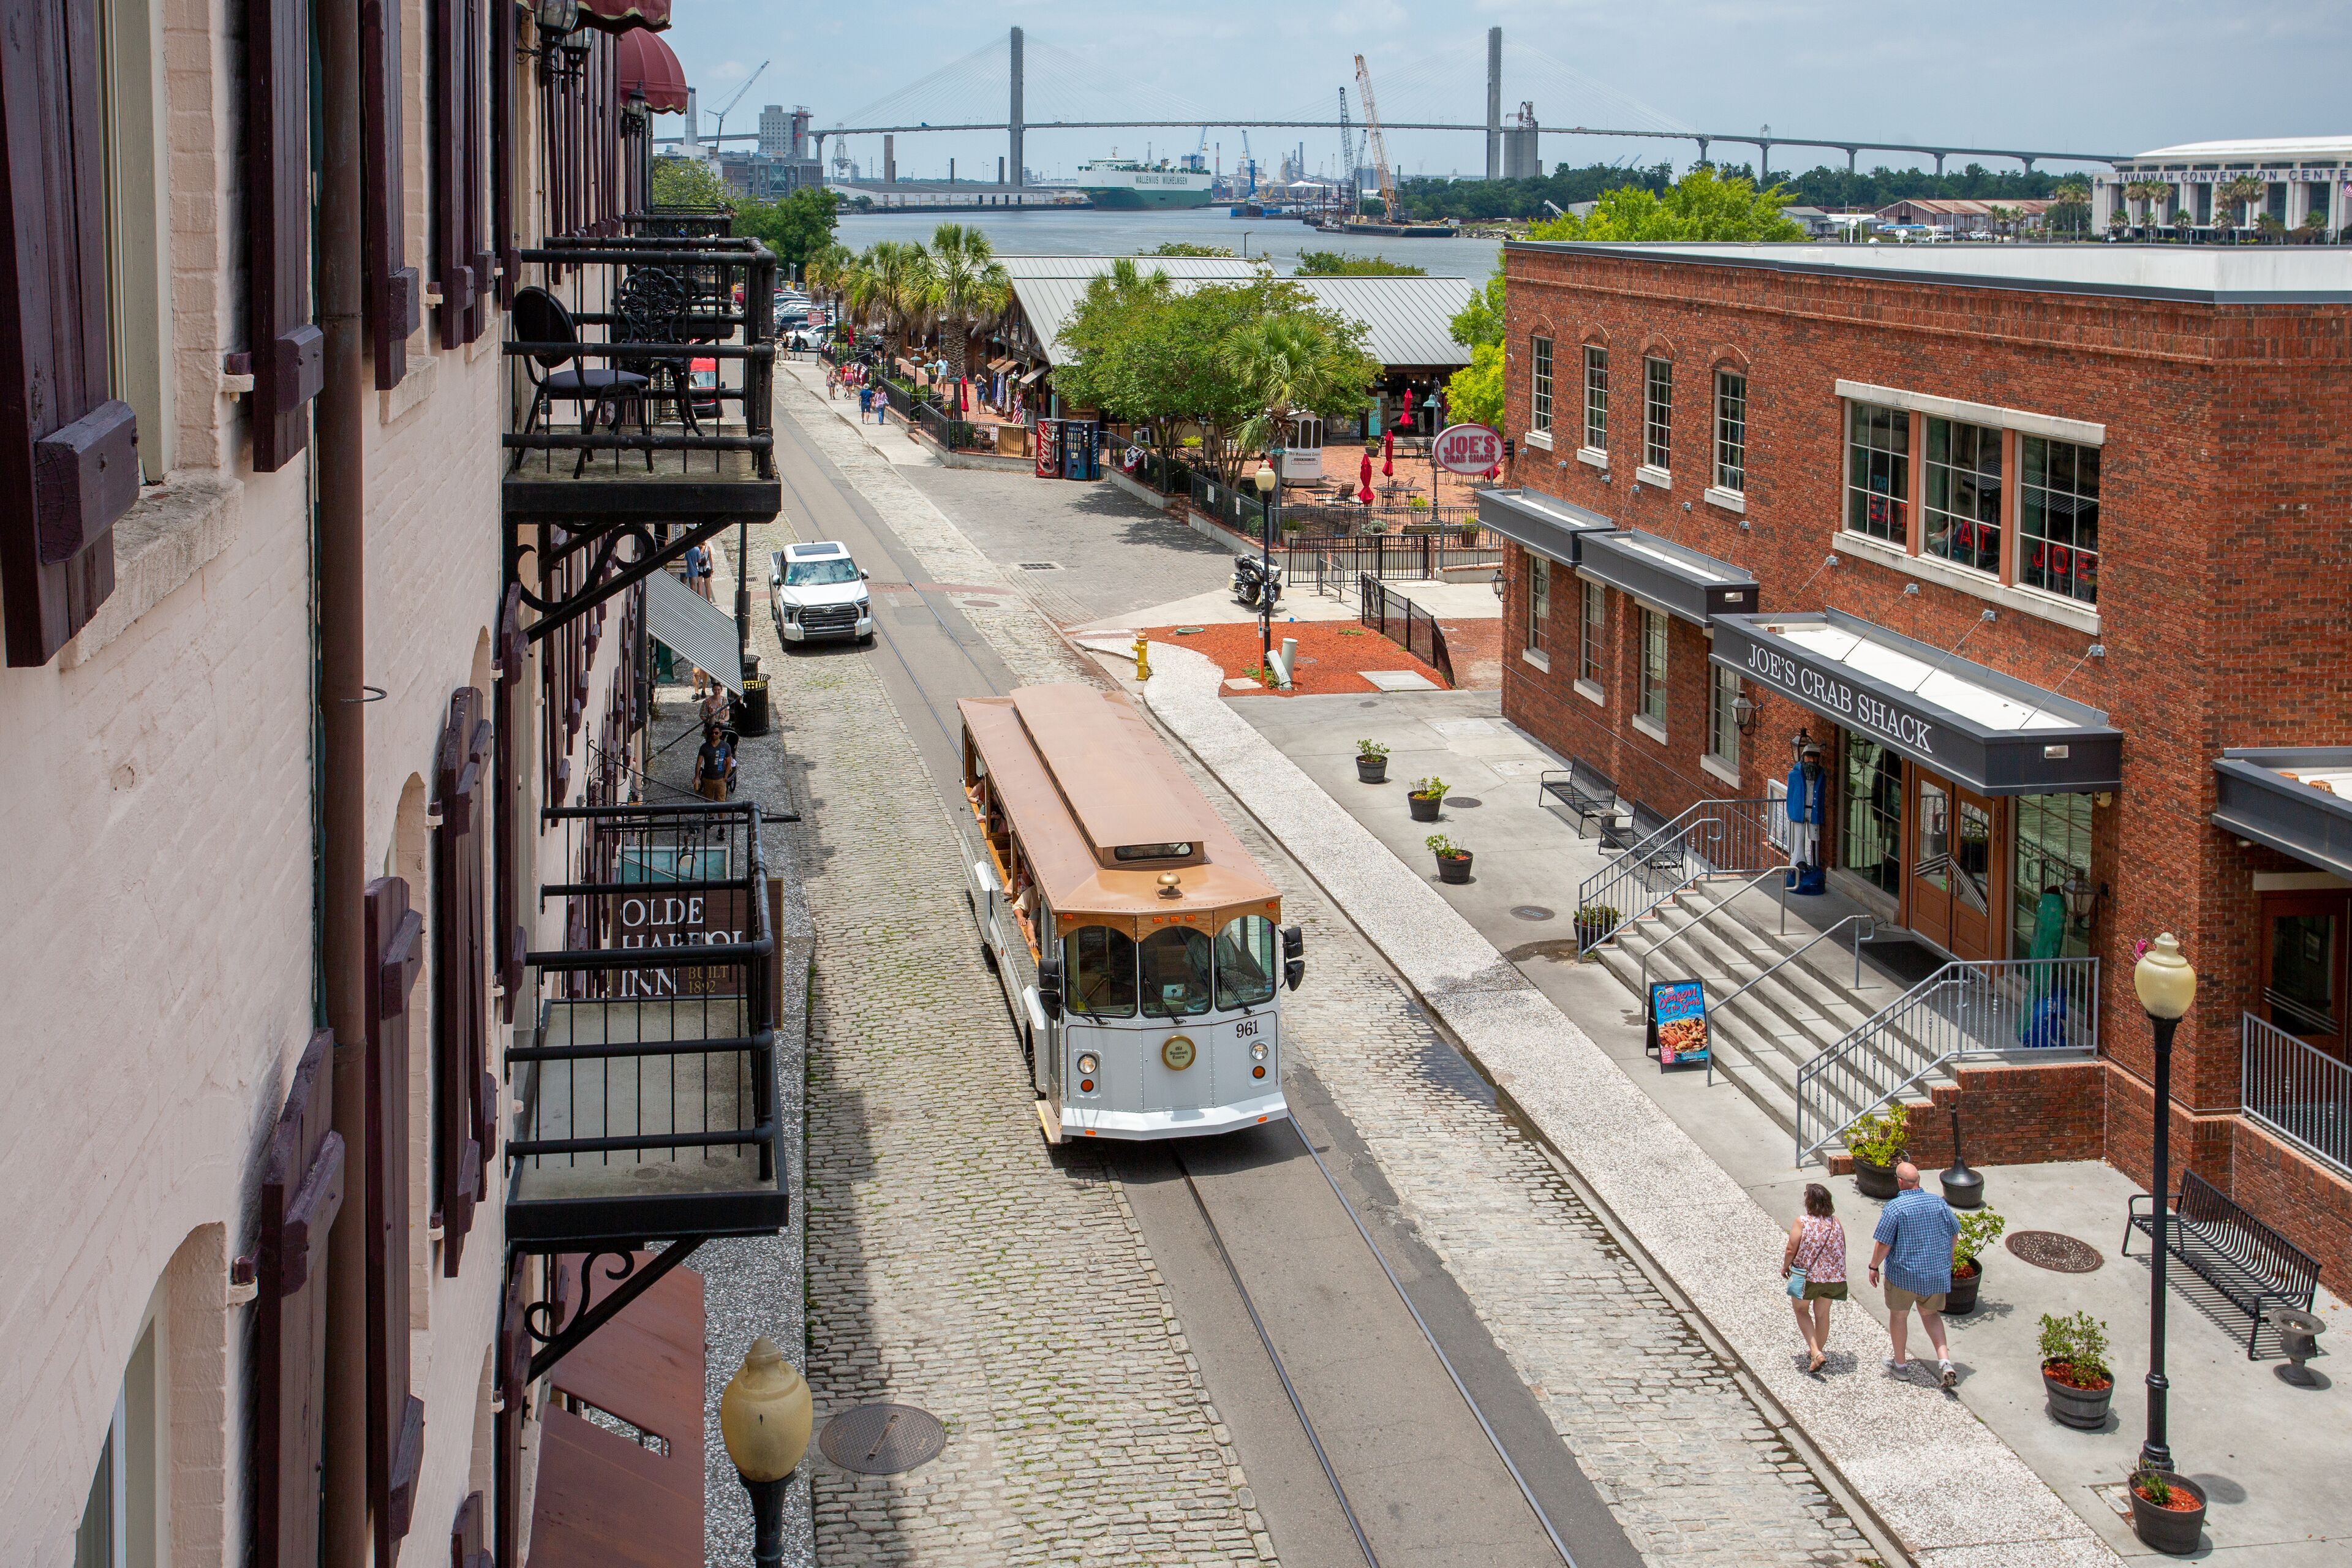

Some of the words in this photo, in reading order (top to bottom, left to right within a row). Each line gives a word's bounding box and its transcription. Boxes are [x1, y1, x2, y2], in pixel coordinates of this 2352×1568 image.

[1136, 176, 1158, 184] WALLENIUS
[1163, 176, 1187, 185] WILHELMSEN
[2119, 172, 2173, 183] SAVANNAH
[1443, 435, 1496, 454] JOE'S
[1444, 454, 1466, 464] CRAB
[1468, 454, 1496, 464] SHACK
[1960, 521, 1990, 551] AT
[1748, 644, 1796, 687] JOE'S
[1801, 668, 1852, 713] CRAB
[1858, 694, 1932, 753] SHACK
[620, 897, 704, 926] OLDE
[620, 968, 679, 997] INN
[1656, 986, 1697, 1009] Season
[1679, 997, 1700, 1014] Seas
[1236, 1019, 1259, 1038] 961
